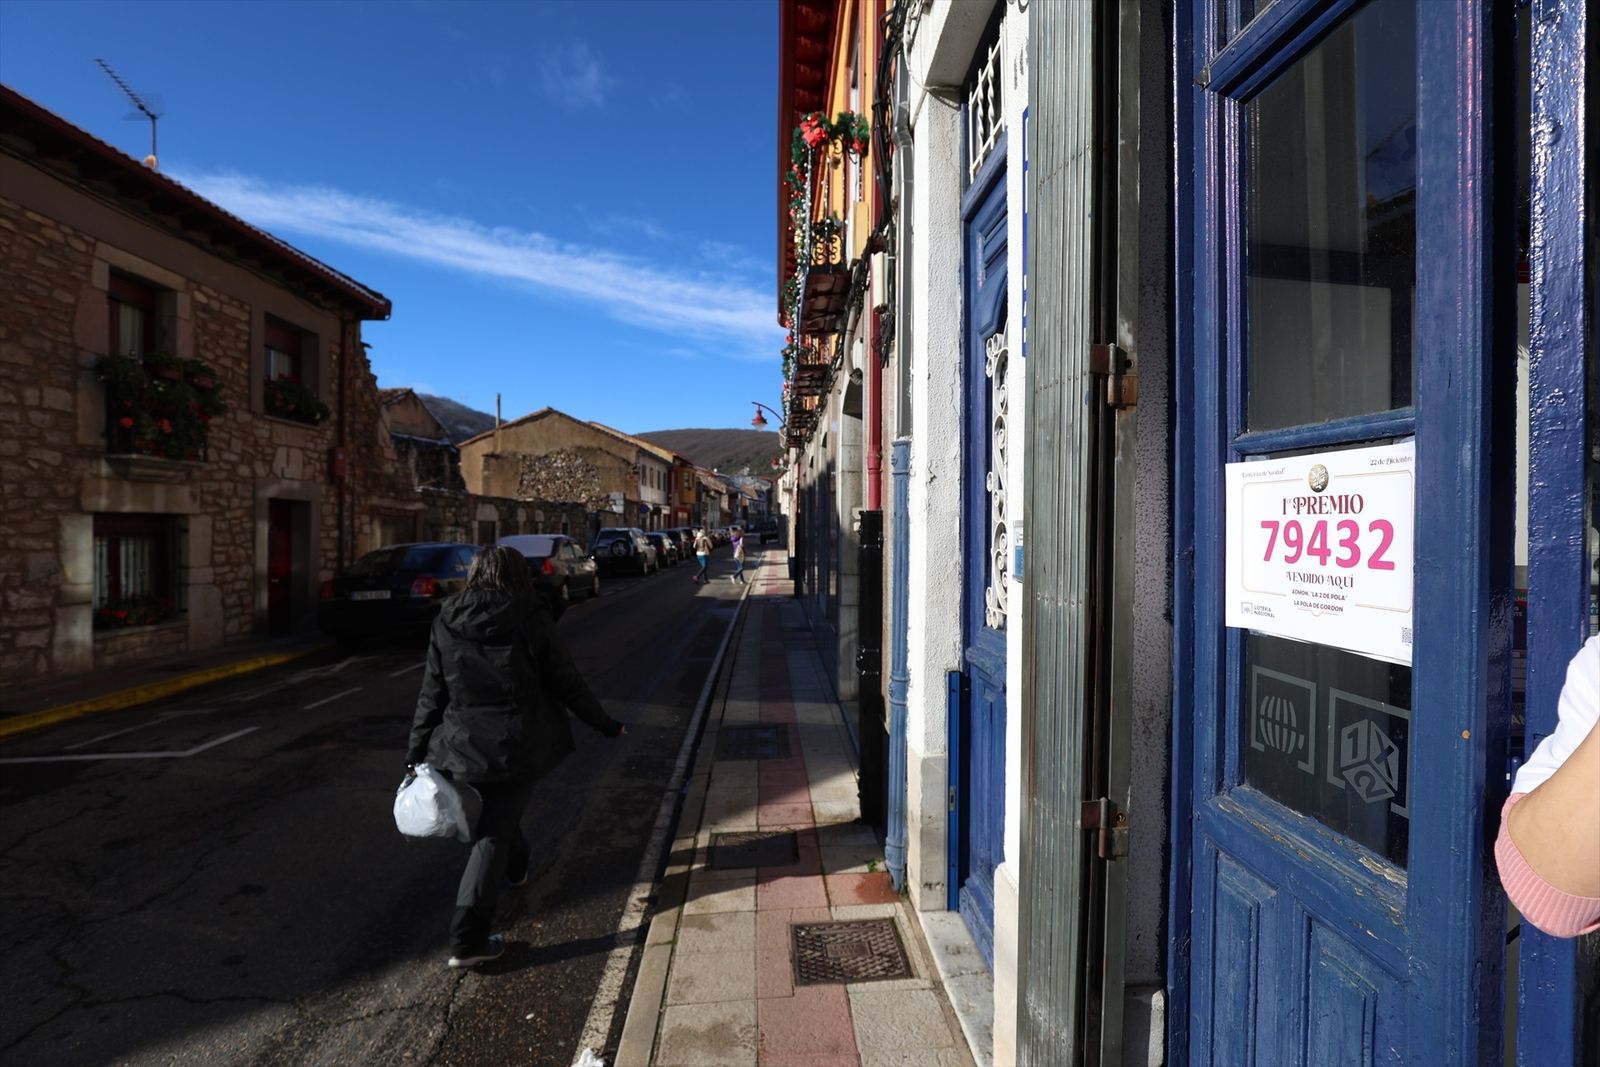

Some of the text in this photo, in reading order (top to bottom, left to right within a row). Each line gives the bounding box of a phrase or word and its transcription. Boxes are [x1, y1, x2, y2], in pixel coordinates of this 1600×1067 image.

[1292, 493, 1364, 515] PREMIO
[1260, 519, 1395, 571] 79432
[1285, 570, 1354, 590] VENDIDO AQUÍ
